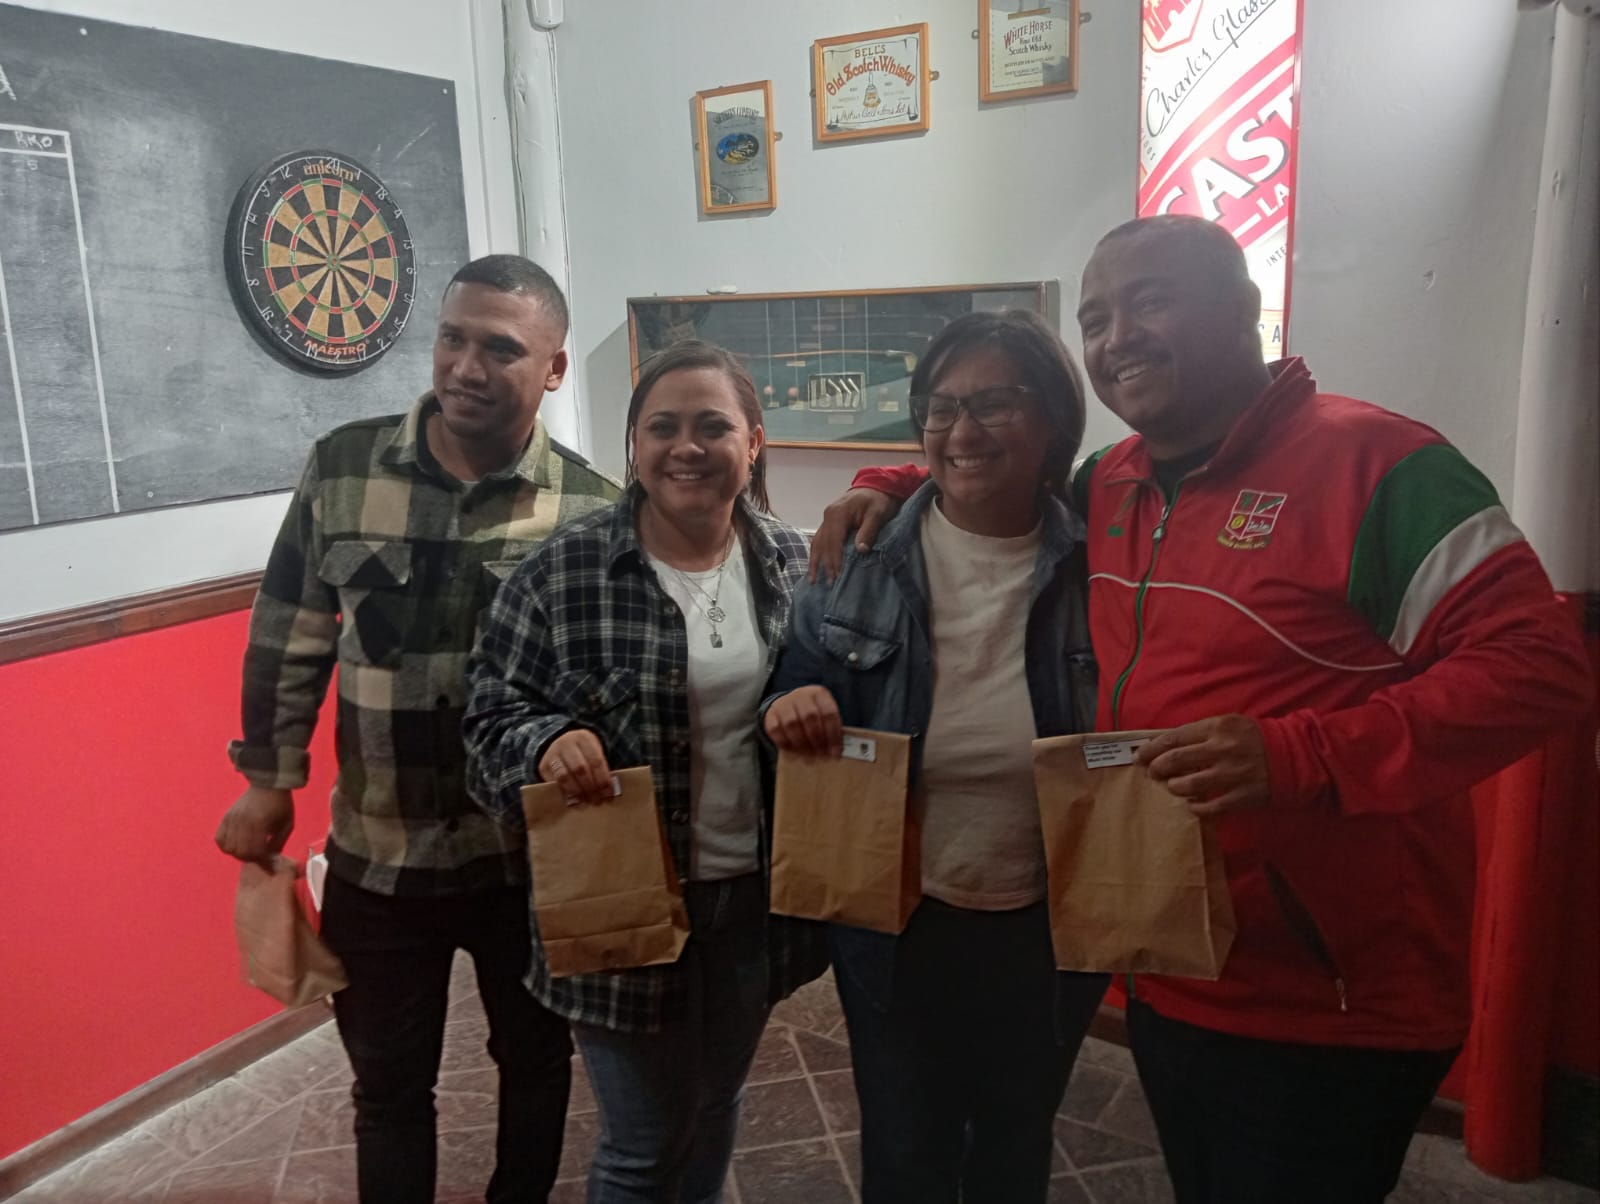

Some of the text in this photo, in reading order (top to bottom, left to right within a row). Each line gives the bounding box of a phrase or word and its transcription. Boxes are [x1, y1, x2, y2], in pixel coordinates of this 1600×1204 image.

[1003, 20, 1053, 49] WHITE HORSE
[855, 44, 886, 58] BELL'S
[1008, 41, 1053, 56] Scotch Whisky
[826, 55, 916, 96] Old Scotch Whisky
[280, 164, 293, 180] 12
[303, 159, 354, 181] unicorn
[260, 184, 271, 198] 9
[375, 186, 389, 201] 18
[1256, 182, 1290, 217] LA
[393, 208, 403, 220] 4
[247, 278, 260, 287] 8
[261, 306, 275, 321] 16
[304, 340, 367, 356] MAESTRO
[377, 338, 388, 350] 2
